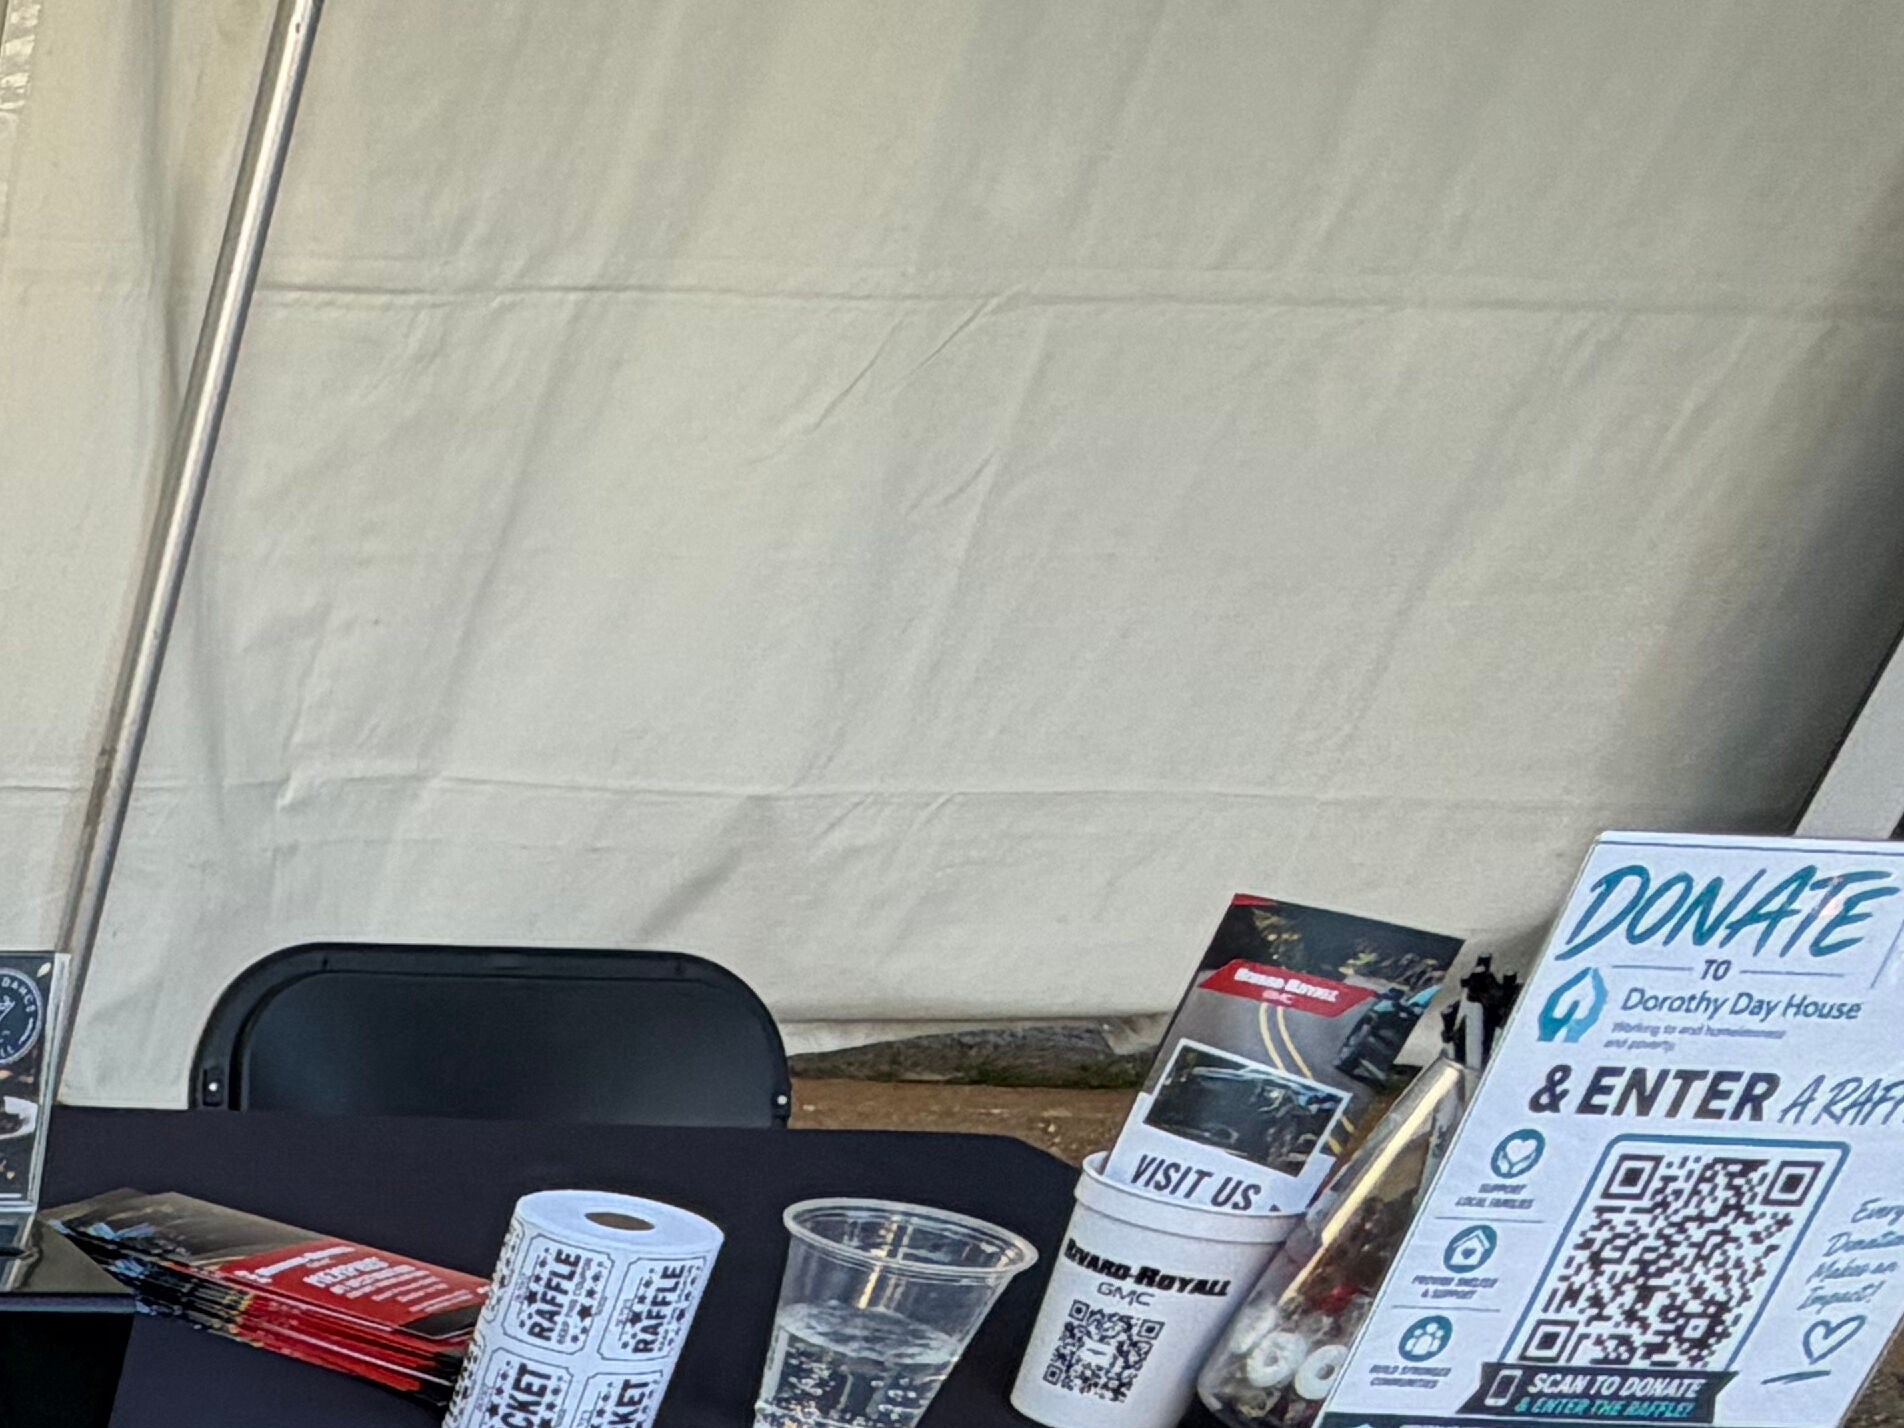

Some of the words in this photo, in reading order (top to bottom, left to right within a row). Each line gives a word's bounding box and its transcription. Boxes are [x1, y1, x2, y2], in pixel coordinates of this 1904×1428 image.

[1555, 864, 1901, 962] DONATE
[1699, 959, 1732, 981] TO
[1621, 987, 1729, 1020] Dorothy
[1729, 992, 1782, 1022] Day
[1780, 993, 1863, 1020] House
[1528, 1064, 1573, 1114] &
[1575, 1066, 1782, 1121] ENTER
[1777, 1074, 1826, 1124] A
[1131, 1154, 1213, 1199] VISIT
[1210, 1176, 1261, 1211] US
[527, 1248, 582, 1342] RAFFLE
[632, 1264, 686, 1354] RAFFLE
[1097, 1281, 1155, 1307] GMC
[1526, 1373, 1592, 1394] SCAN
[1590, 1375, 1618, 1396] TO
[1619, 1377, 1708, 1398] DONATE
[1530, 1397, 1590, 1415] ENTER
[1590, 1400, 1623, 1416] THE
[1623, 1401, 1696, 1418] RAFFLE!
